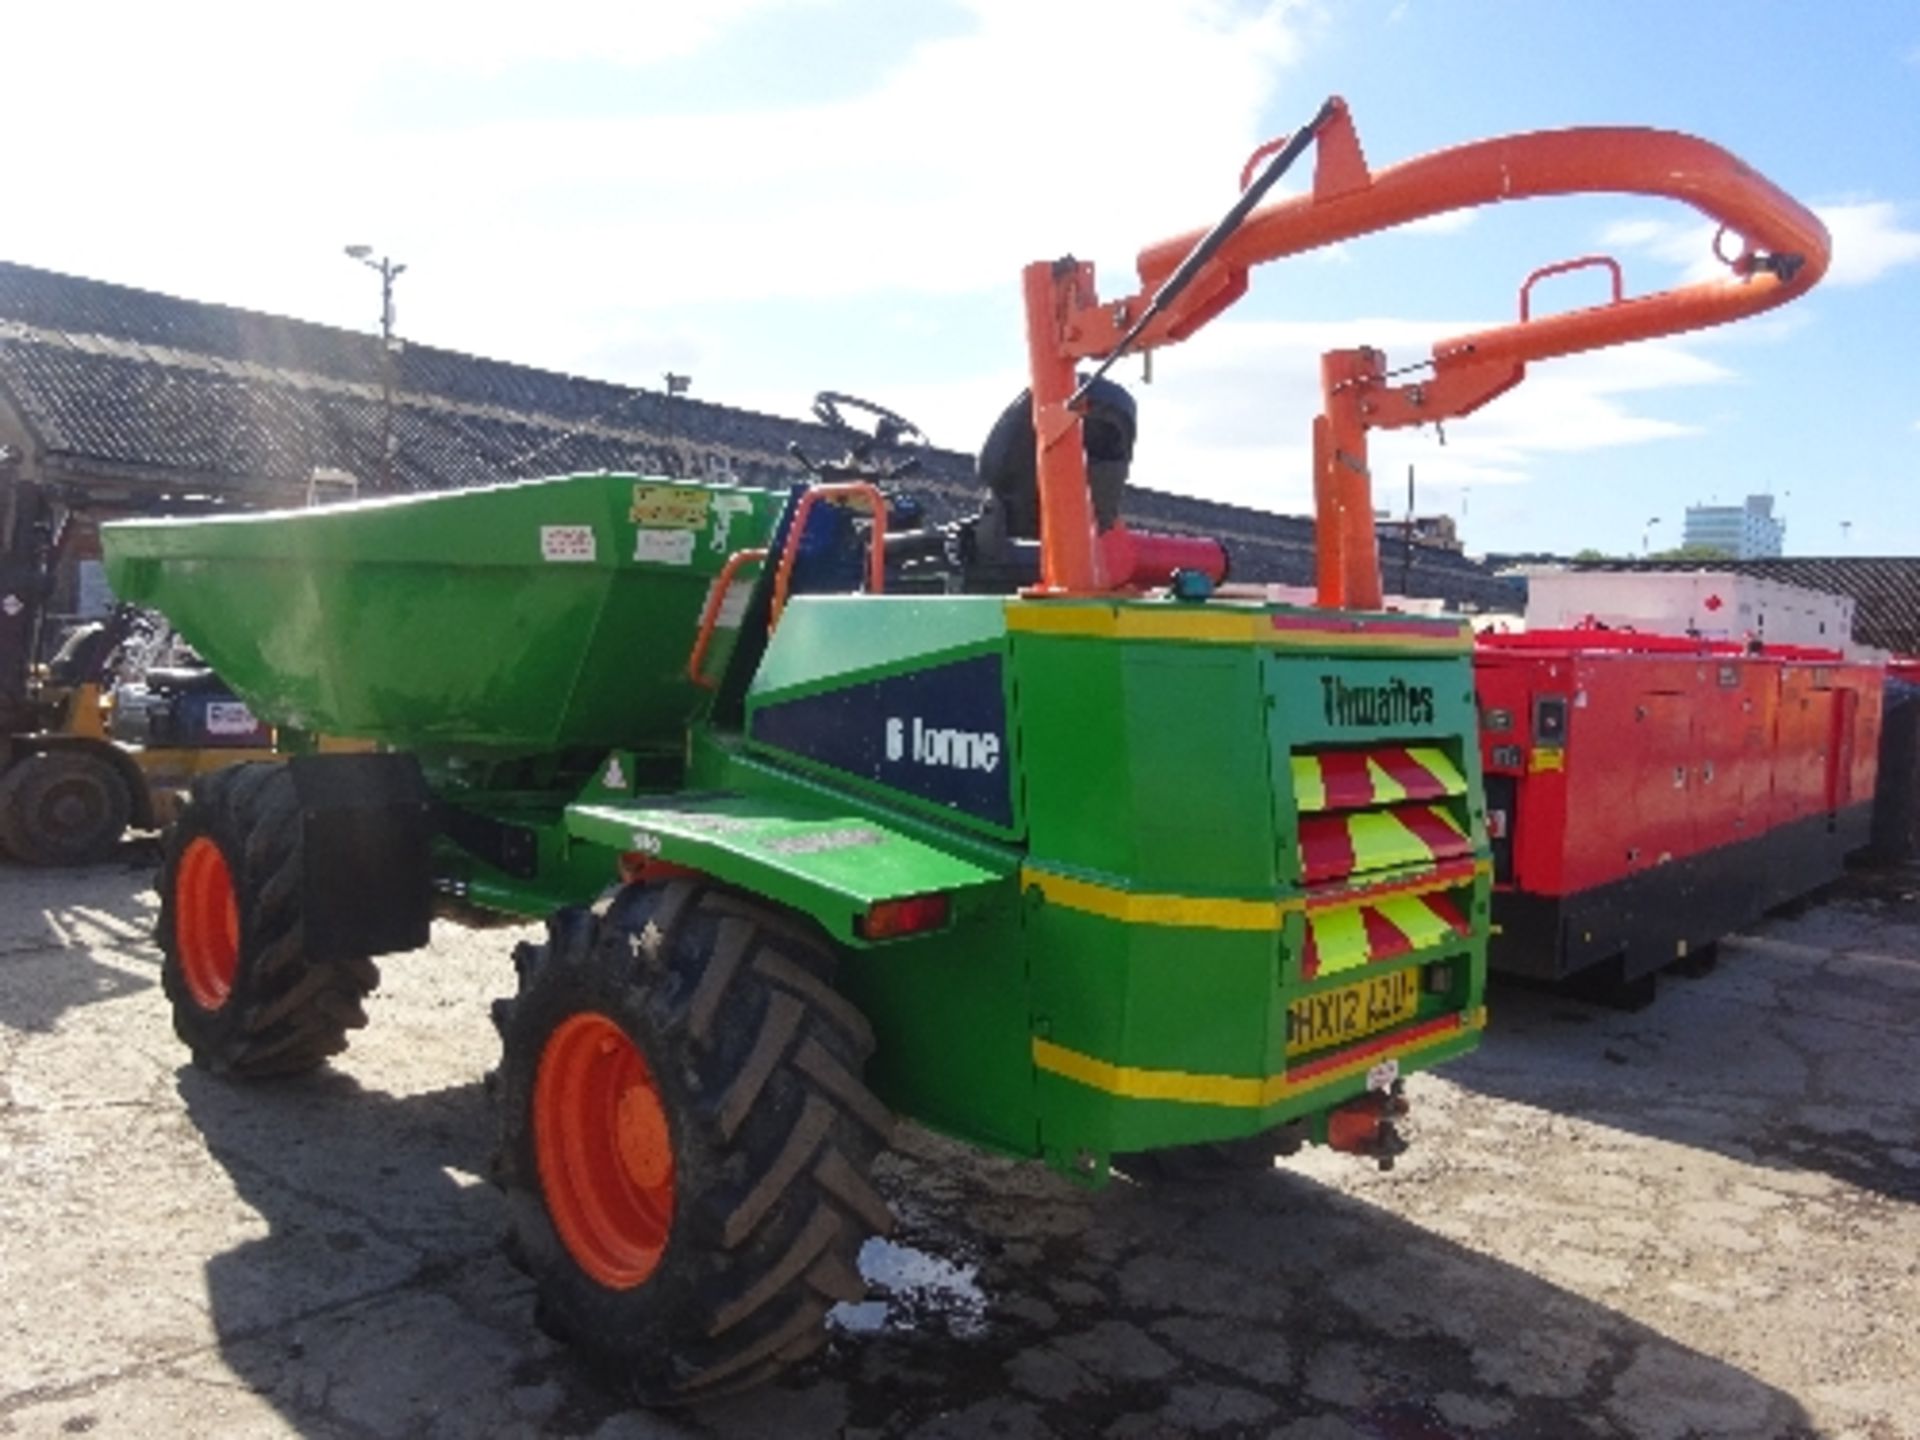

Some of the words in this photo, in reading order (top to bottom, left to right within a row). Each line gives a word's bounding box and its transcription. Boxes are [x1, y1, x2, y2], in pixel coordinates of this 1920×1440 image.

[1320, 675, 1434, 726] Thwaites
[885, 717, 904, 762] 6
[912, 717, 1000, 773] Tonne
[1296, 989, 1360, 1045] HX12
